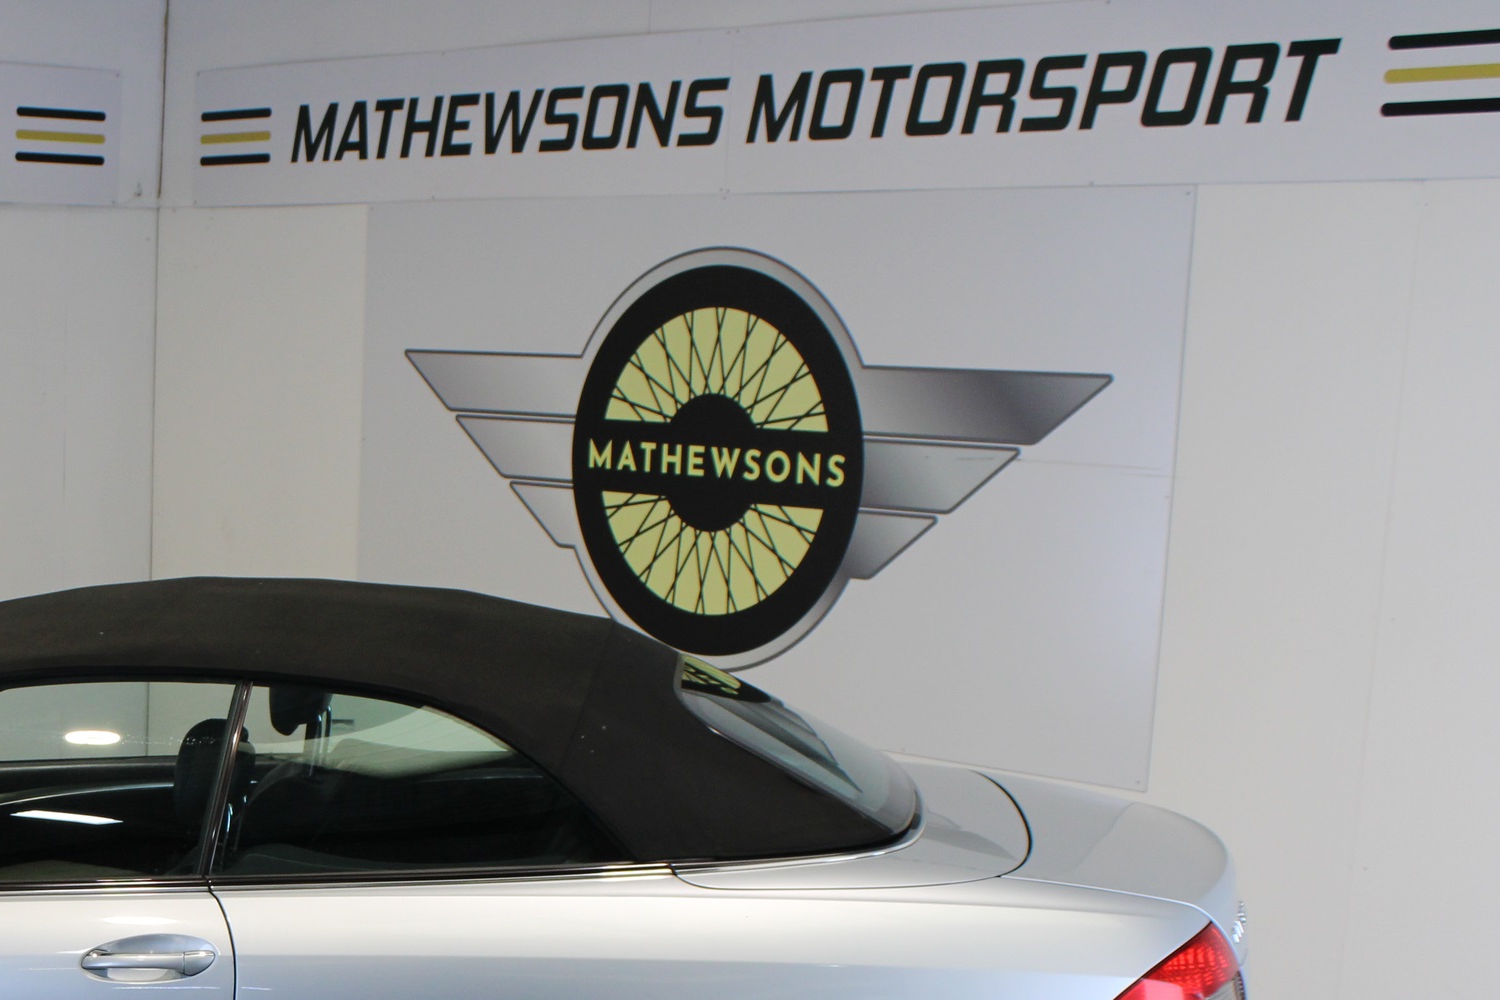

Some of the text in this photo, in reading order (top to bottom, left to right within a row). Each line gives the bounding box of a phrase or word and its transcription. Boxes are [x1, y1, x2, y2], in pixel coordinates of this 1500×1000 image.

[290, 37, 1342, 164] MATHEWSONS MOTORSPORT
[587, 437, 847, 488] MATHEWSONS
